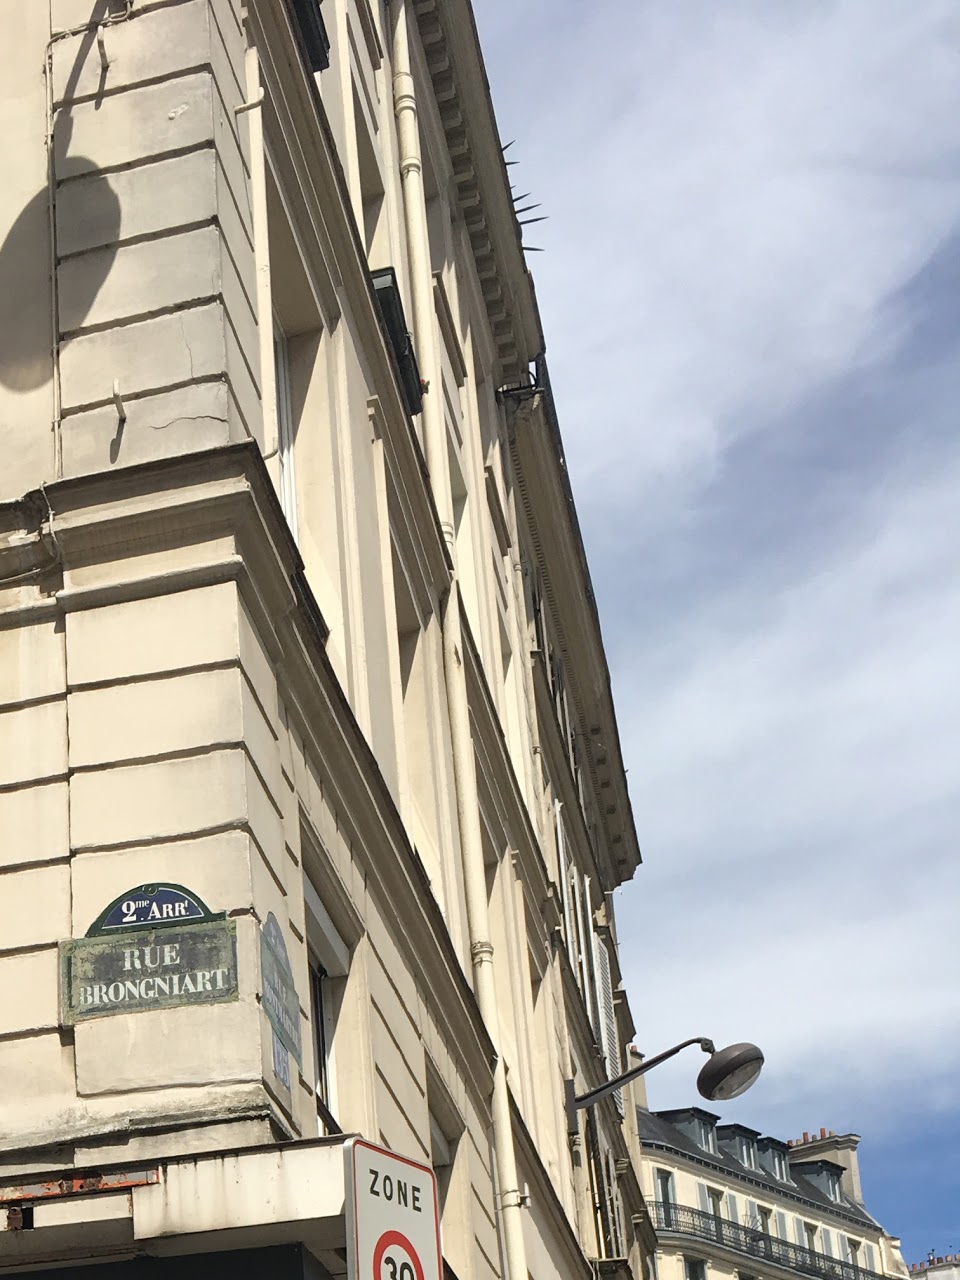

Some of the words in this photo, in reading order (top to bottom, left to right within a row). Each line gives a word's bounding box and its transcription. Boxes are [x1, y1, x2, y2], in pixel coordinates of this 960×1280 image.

[122, 944, 180, 970] RUE
[79, 968, 228, 1006] BRONGNIART
[368, 1168, 421, 1213] ZONE
